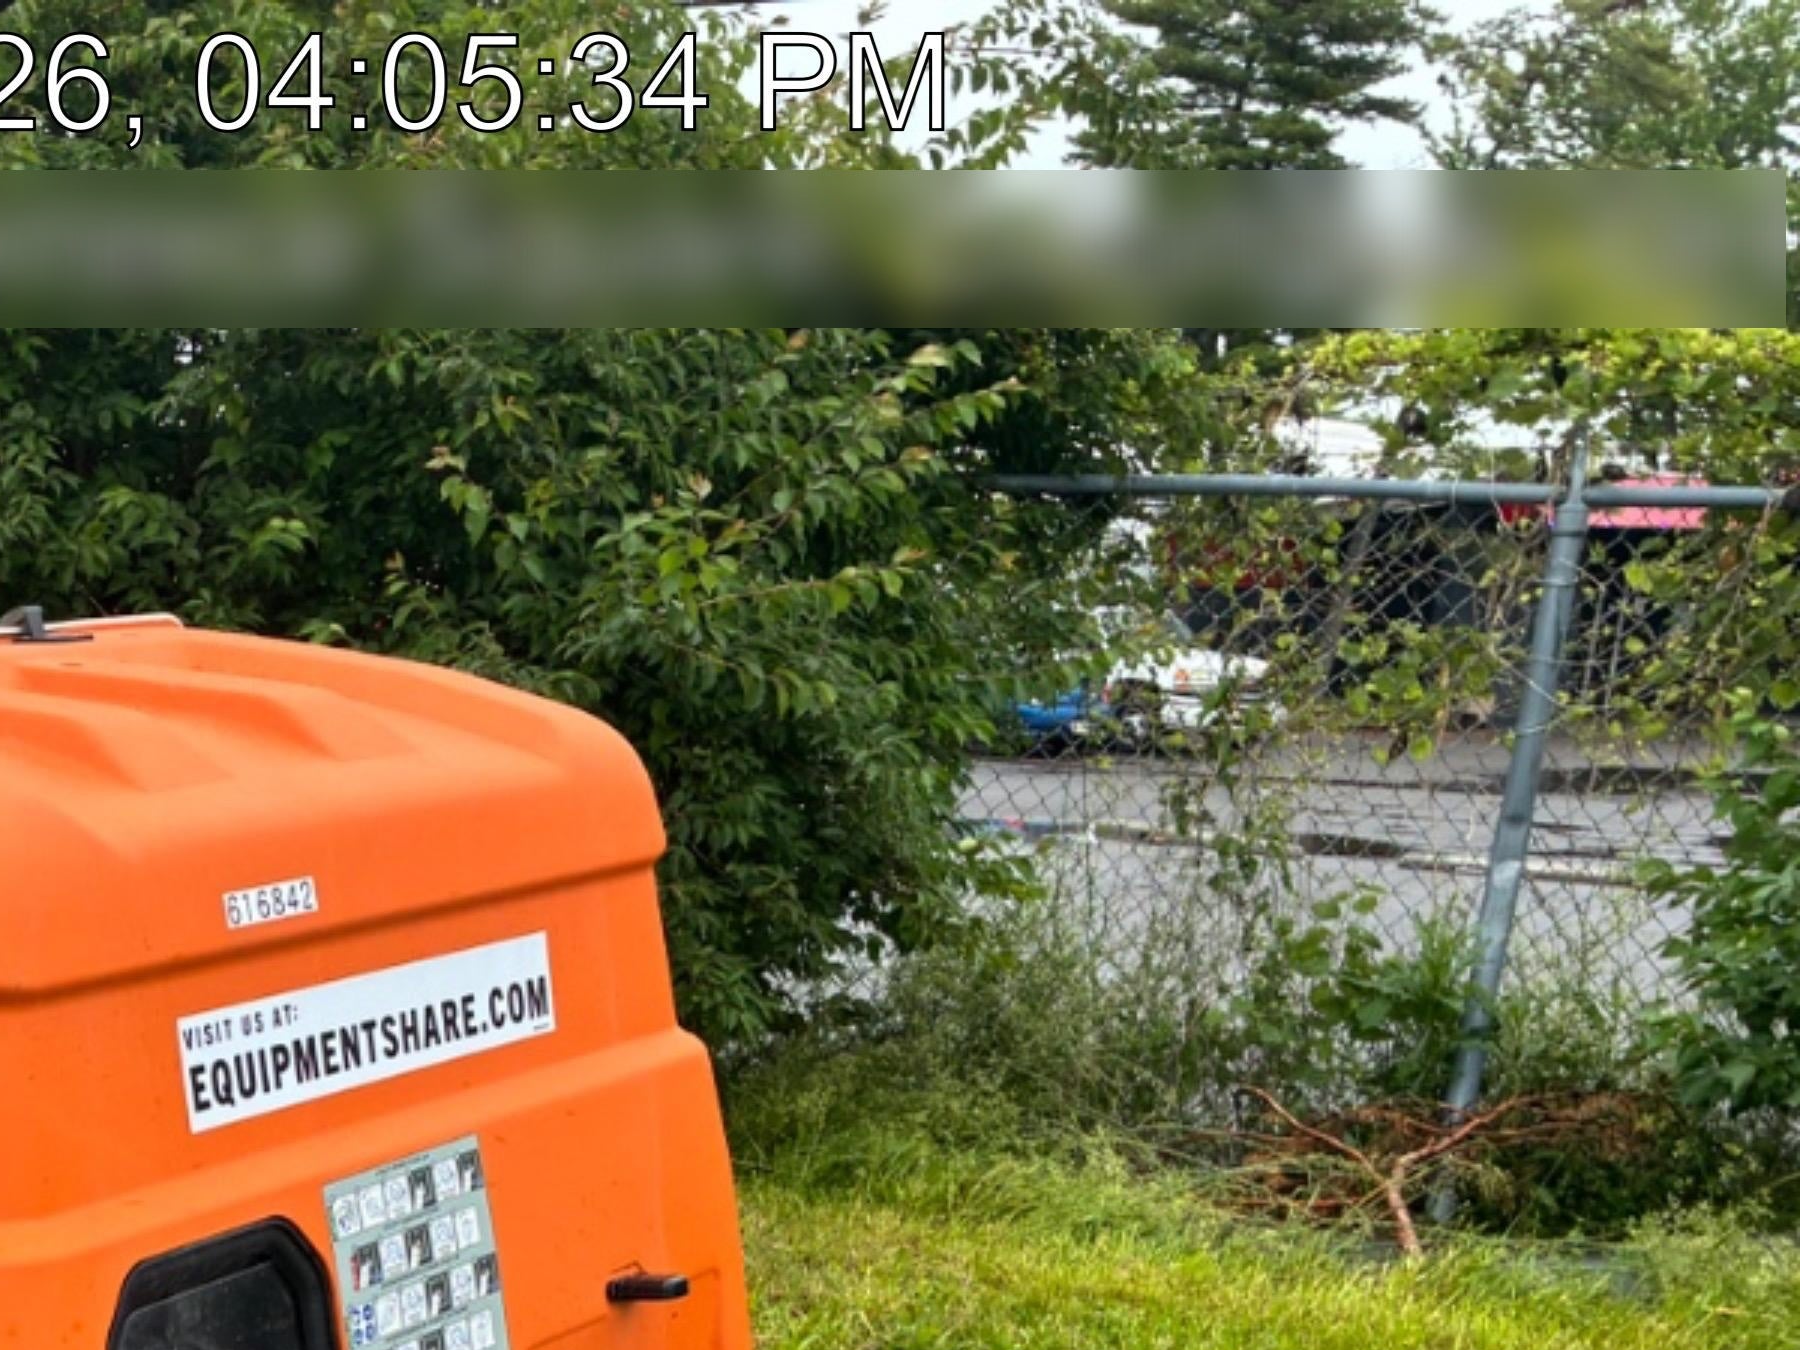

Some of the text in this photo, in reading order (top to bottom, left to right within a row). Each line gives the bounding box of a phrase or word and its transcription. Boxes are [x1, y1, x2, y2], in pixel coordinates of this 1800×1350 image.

[228, 881, 313, 926] 616842
[183, 1004, 299, 1051] VISIT US AT:
[189, 975, 550, 1112] EQUIPMENTSHARE.COM
